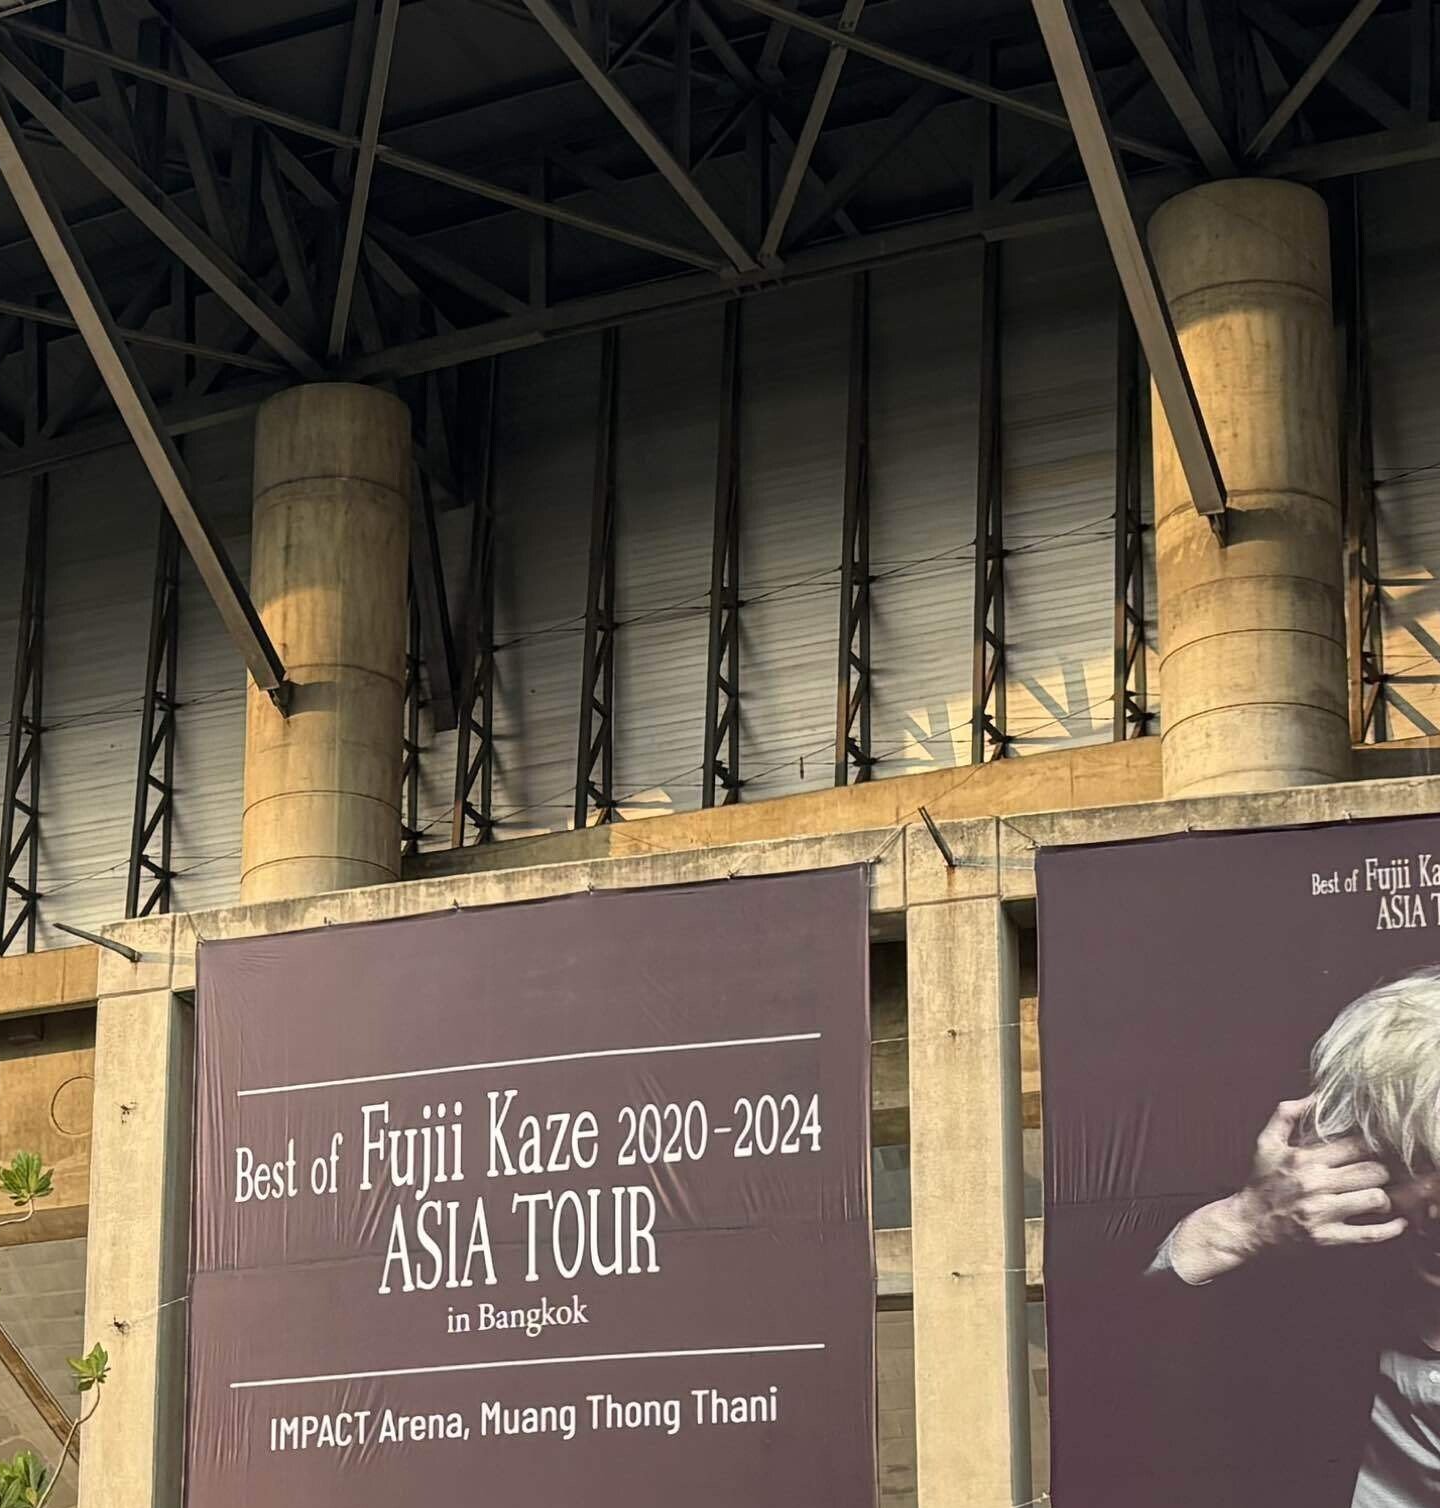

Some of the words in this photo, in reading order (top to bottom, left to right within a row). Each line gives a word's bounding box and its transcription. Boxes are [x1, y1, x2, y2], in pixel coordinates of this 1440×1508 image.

[1312, 873, 1340, 896] Best
[1344, 868, 1360, 894] of
[1365, 857, 1411, 895] Fujii
[1376, 893, 1427, 930] ASIA
[234, 1139, 298, 1203] Best
[311, 1132, 344, 1195] of
[359, 1101, 465, 1200] Fujii
[487, 1089, 599, 1177] Kaze
[617, 1094, 822, 1166] 2020-2024
[378, 1196, 498, 1294] ASIA
[511, 1186, 661, 1282] TOUR
[447, 1307, 470, 1334] in
[478, 1294, 589, 1337] Bangkok
[270, 1410, 370, 1451] IMPACT
[378, 1407, 470, 1443] Arena,
[481, 1401, 576, 1441] Muang
[586, 1393, 680, 1435] Thong
[691, 1386, 779, 1425] Thani
